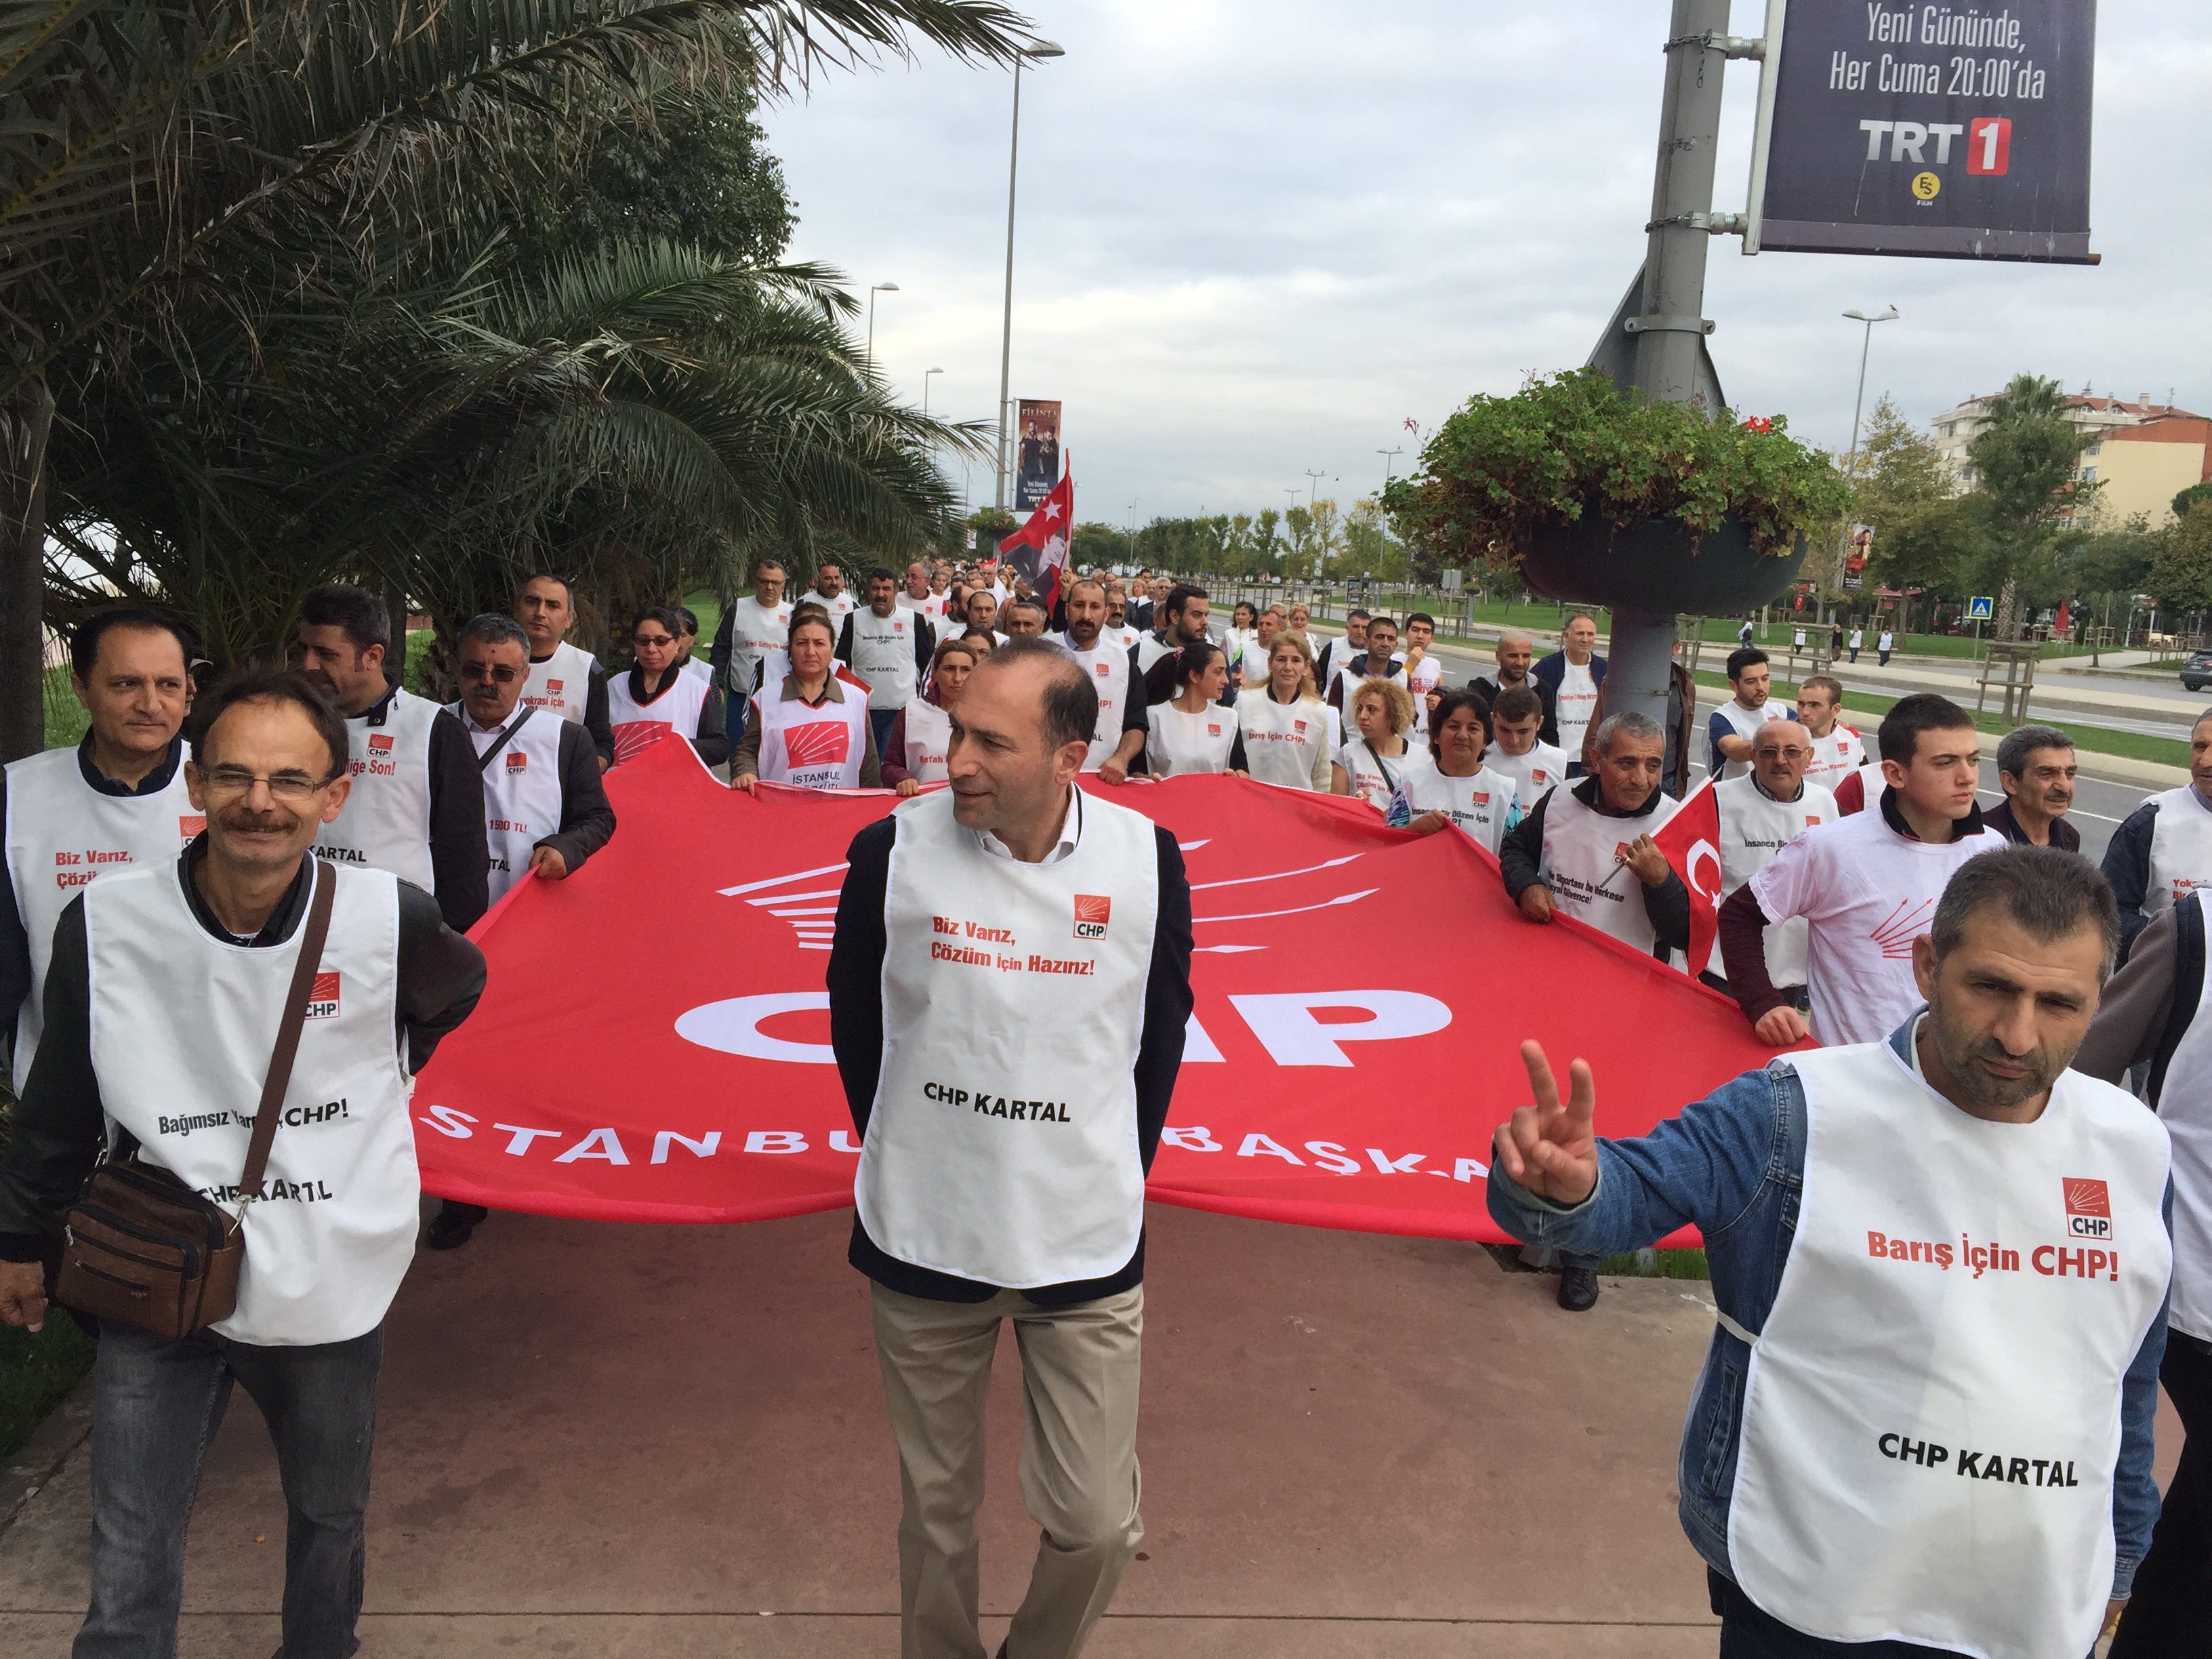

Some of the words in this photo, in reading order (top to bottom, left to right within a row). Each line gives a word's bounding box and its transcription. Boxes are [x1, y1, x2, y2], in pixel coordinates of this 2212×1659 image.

[1867, 1, 1913, 42] Yeni
[1921, 5, 2026, 54] Gününde,
[1830, 51, 1871, 91] Her
[1879, 56, 1940, 94] Cuma
[1947, 58, 2045, 99] 20:00'da
[1860, 119, 1963, 164] TRT
[1978, 123, 1999, 169] 1
[1098, 699, 1112, 709] HP!
[1285, 733, 1305, 745] CHP!
[369, 748, 389, 756] CHP
[369, 759, 396, 776] Son!
[792, 771, 840, 785] İSTANBUL
[489, 819, 510, 831] 1500
[514, 822, 527, 833] TL!
[1452, 810, 1474, 821] Düzen
[1476, 813, 1489, 824] İçin
[56, 852, 81, 865] Biz
[86, 850, 133, 864] Varız,
[490, 859, 511, 872] TAL
[57, 871, 100, 890] Çözü
[1595, 885, 1625, 903] Herkese
[933, 916, 959, 935] Biz
[965, 920, 1016, 946] Varız,
[1078, 923, 1104, 937] CHP
[931, 942, 991, 966] Çözüm
[1028, 954, 1094, 975] Hazırız!
[674, 989, 1452, 1067] CP
[924, 1082, 969, 1107] CHP
[975, 1092, 1071, 1123] KARTAL
[285, 1099, 348, 1126] CHP!
[159, 1109, 229, 1136] Bağımsız
[418, 1105, 863, 1166] STANBU
[1161, 1126, 1489, 1183] BAŞKA
[2072, 1218, 2108, 1236] CHP
[1867, 1231, 1954, 1270] Barış
[1963, 1233, 2020, 1279] İçin
[2032, 1245, 2118, 1282] CHP!
[1879, 1433, 1948, 1469] CHP
[1957, 1449, 2078, 1488] KARTAL
